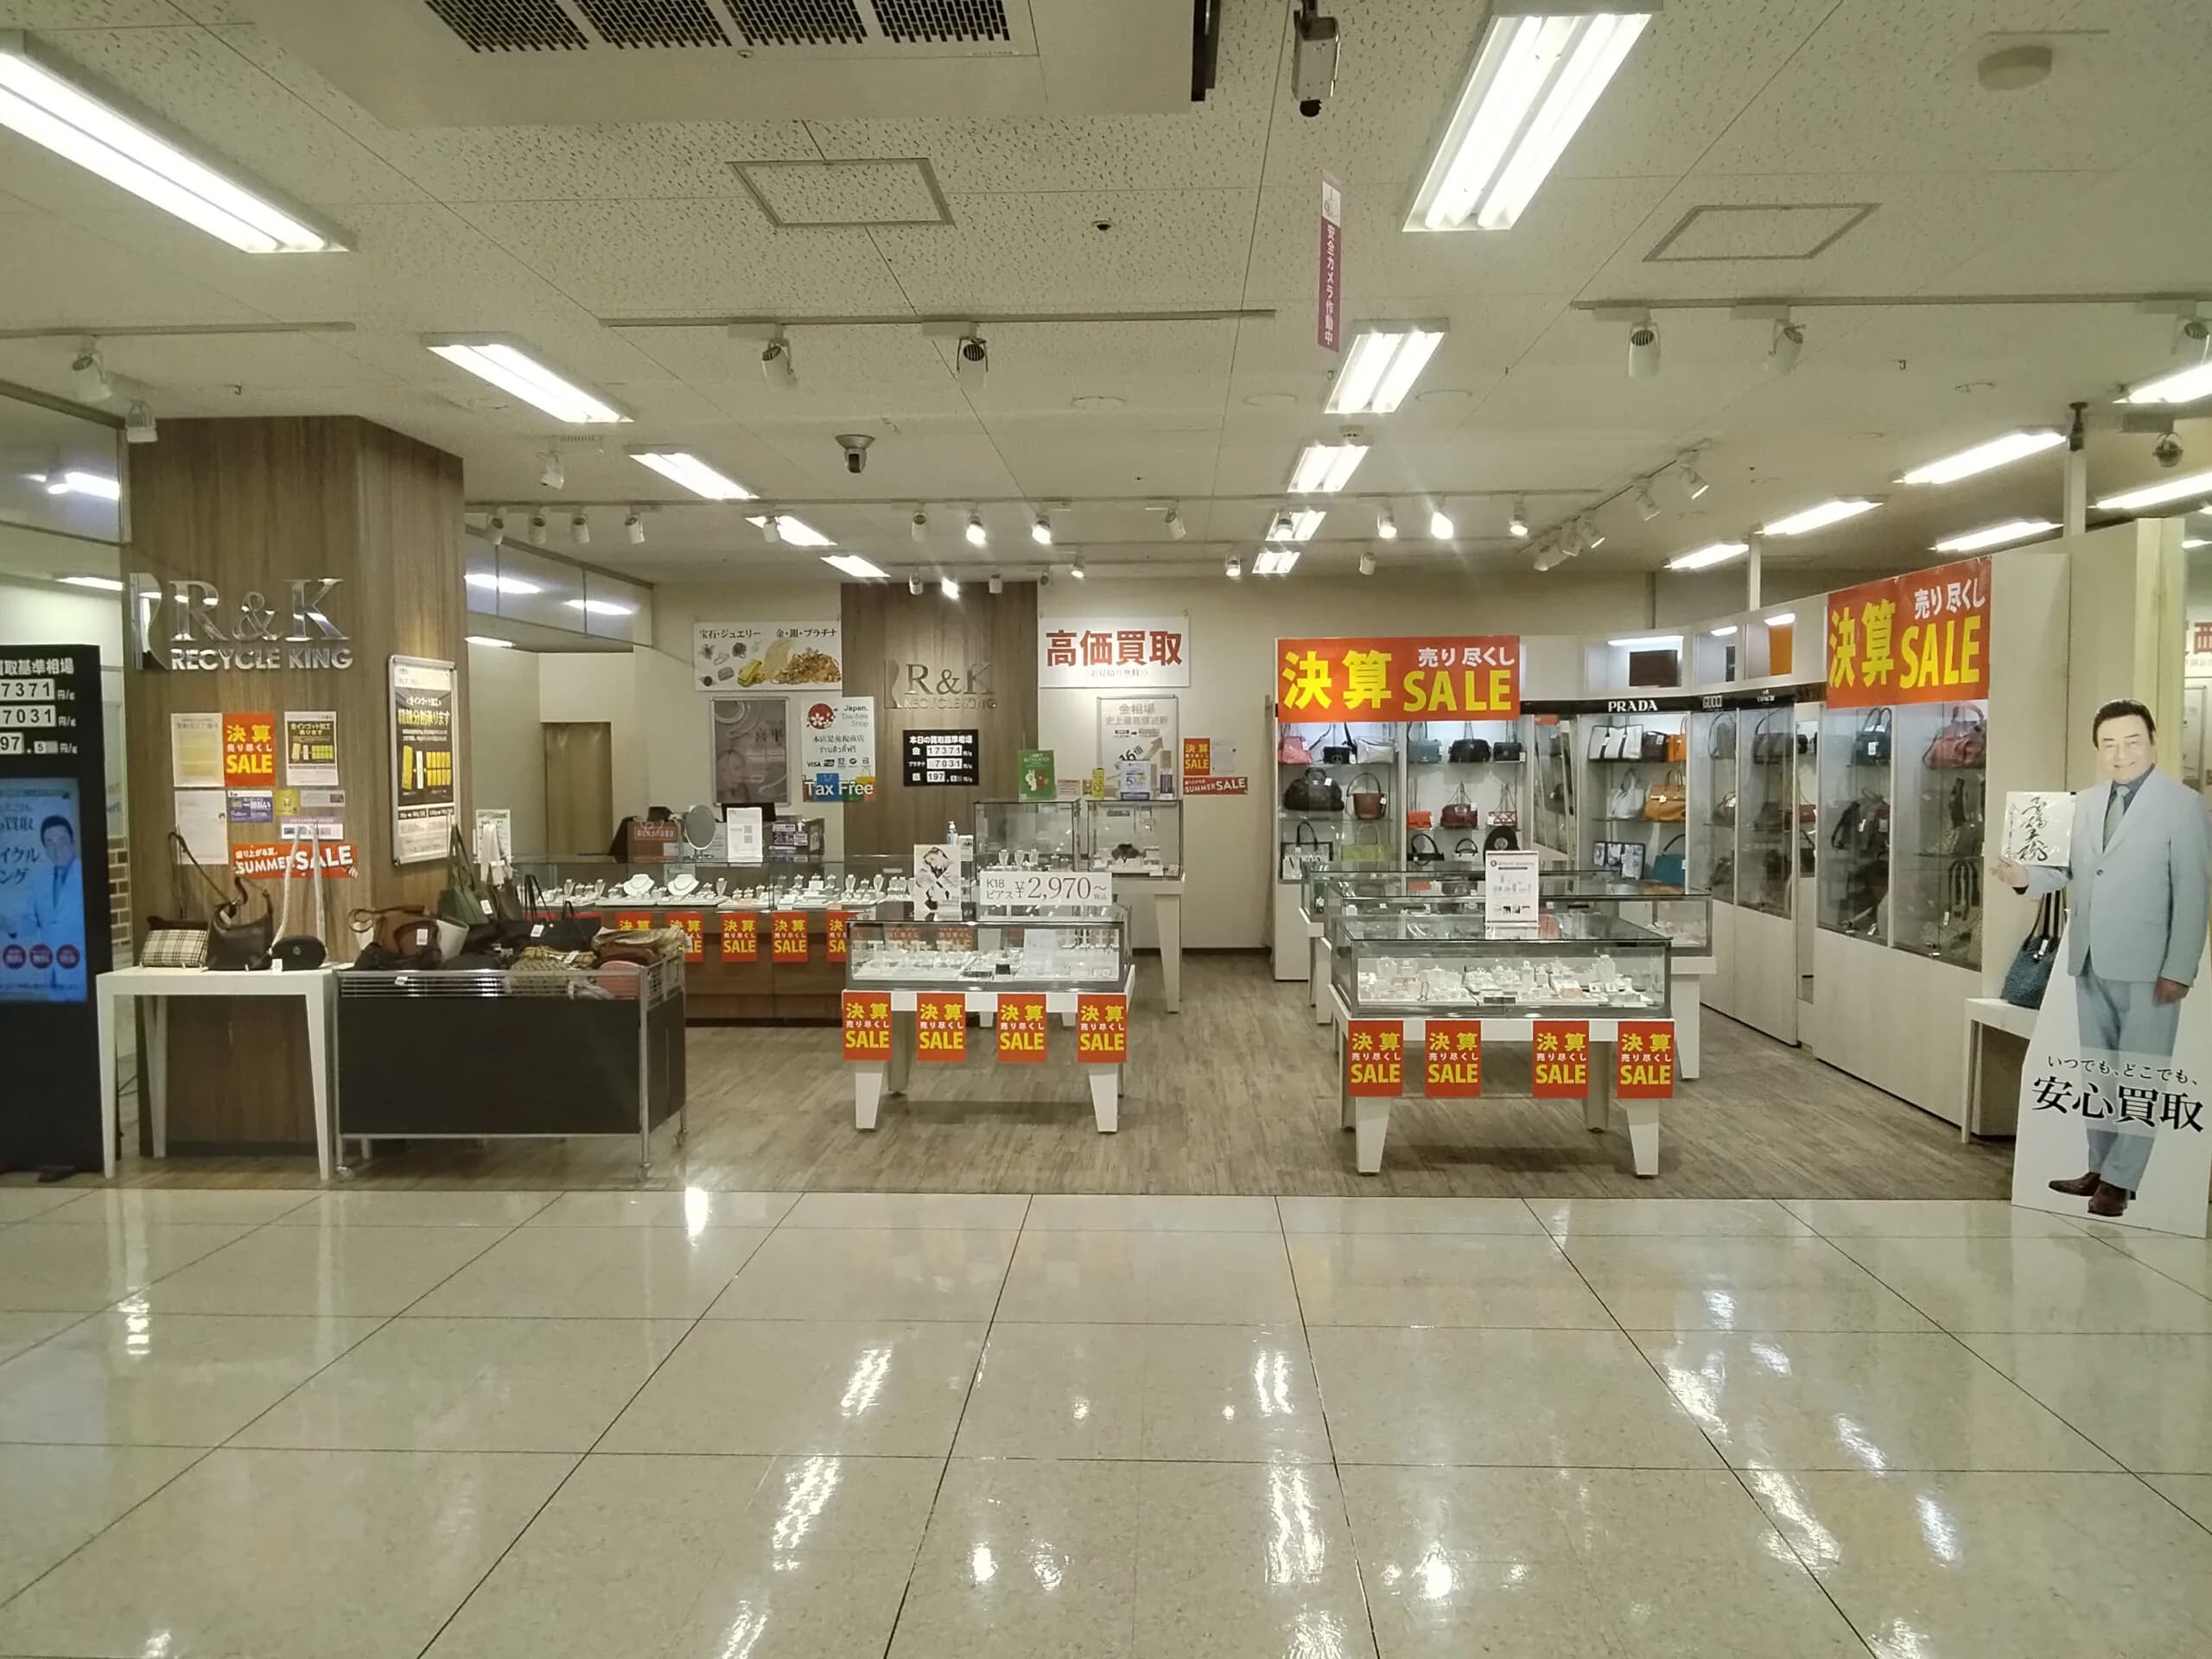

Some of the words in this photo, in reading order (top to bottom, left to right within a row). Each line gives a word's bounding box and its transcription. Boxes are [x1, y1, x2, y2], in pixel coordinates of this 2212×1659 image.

[1914, 577, 1986, 620] 売り尽くし
[1046, 629, 1183, 667] 高価買取
[1828, 598, 1896, 689] 決算
[1899, 614, 1981, 690] SALE
[171, 648, 281, 671] RECYCLE
[289, 648, 353, 671] KING
[1418, 646, 1516, 668] 売り尽くし
[1281, 649, 1392, 710] 決算
[1402, 670, 1512, 712] SALE
[1119, 702, 1155, 715] 金相場
[1608, 700, 1659, 713] PRADA
[1703, 695, 1723, 709] GUCCI
[3, 709, 52, 724] 7031
[226, 724, 272, 742] 決算
[226, 743, 273, 753] 売り尽くし
[226, 753, 273, 774] SALE
[1185, 759, 1210, 769] SALE
[804, 780, 835, 796] Tax
[838, 779, 874, 796] Free
[1185, 783, 1217, 793] SUMMER
[1216, 779, 1247, 791] SALE
[0, 816, 34, 831] 買取
[986, 878, 1005, 888] K18
[986, 890, 1013, 900] ピアス
[724, 919, 754, 932] 決算
[774, 919, 805, 932] 決算
[723, 939, 756, 953] SALE
[773, 939, 807, 953] SALE
[846, 1002, 888, 1020] 決算
[919, 1003, 963, 1020] 決算
[1000, 1004, 1043, 1021] 決算
[1080, 1005, 1124, 1022] 決算
[846, 1020, 890, 1029] 売り尽くし
[919, 1021, 963, 1030] 売り尽くし
[1001, 1022, 1045, 1031] 売り尽くし
[1080, 1022, 1125, 1031] 売り尽くし
[845, 1030, 890, 1049] SALE
[918, 1031, 964, 1050] SALE
[999, 1032, 1045, 1051] SALE
[1079, 1033, 1125, 1052] SALE
[1352, 1032, 1400, 1052] 決算
[1429, 1032, 1478, 1052] 決算
[1536, 1033, 1586, 1052] 決算
[1621, 1033, 1671, 1052] 決算
[1351, 1052, 1402, 1061] 売り尽くし
[1429, 1052, 1478, 1061] 売り尽くし
[1536, 1052, 1587, 1062] 売り尽くし
[1621, 1053, 1672, 1063] 売り尽くし
[1351, 1063, 1401, 1084] SALE
[1427, 1063, 1478, 1084] SALE
[1535, 1064, 1586, 1084] SALE
[1619, 1065, 1671, 1085] SALE
[2047, 1055, 2198, 1086] いつでも、どこでも、
[2031, 1076, 2204, 1134] 安心買取
